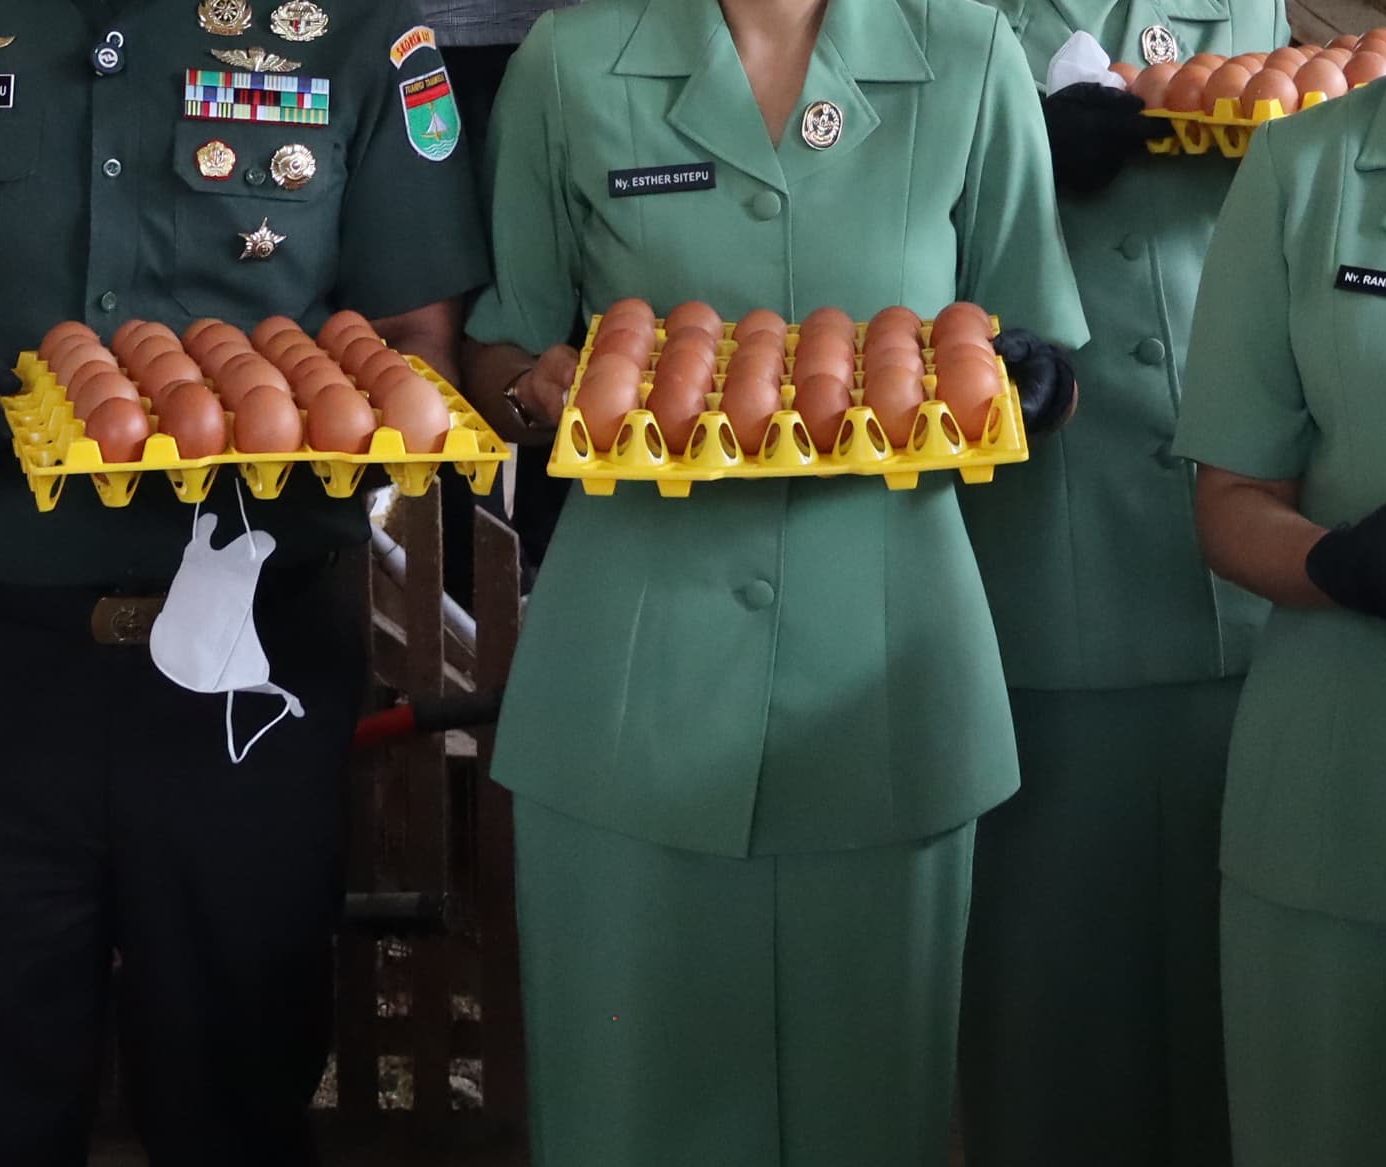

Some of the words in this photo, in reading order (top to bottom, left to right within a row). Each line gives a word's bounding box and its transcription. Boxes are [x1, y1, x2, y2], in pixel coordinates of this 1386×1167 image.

[615, 178, 630, 190] Ny.
[632, 174, 671, 187] ESTHER
[673, 170, 709, 183] SITEPU
